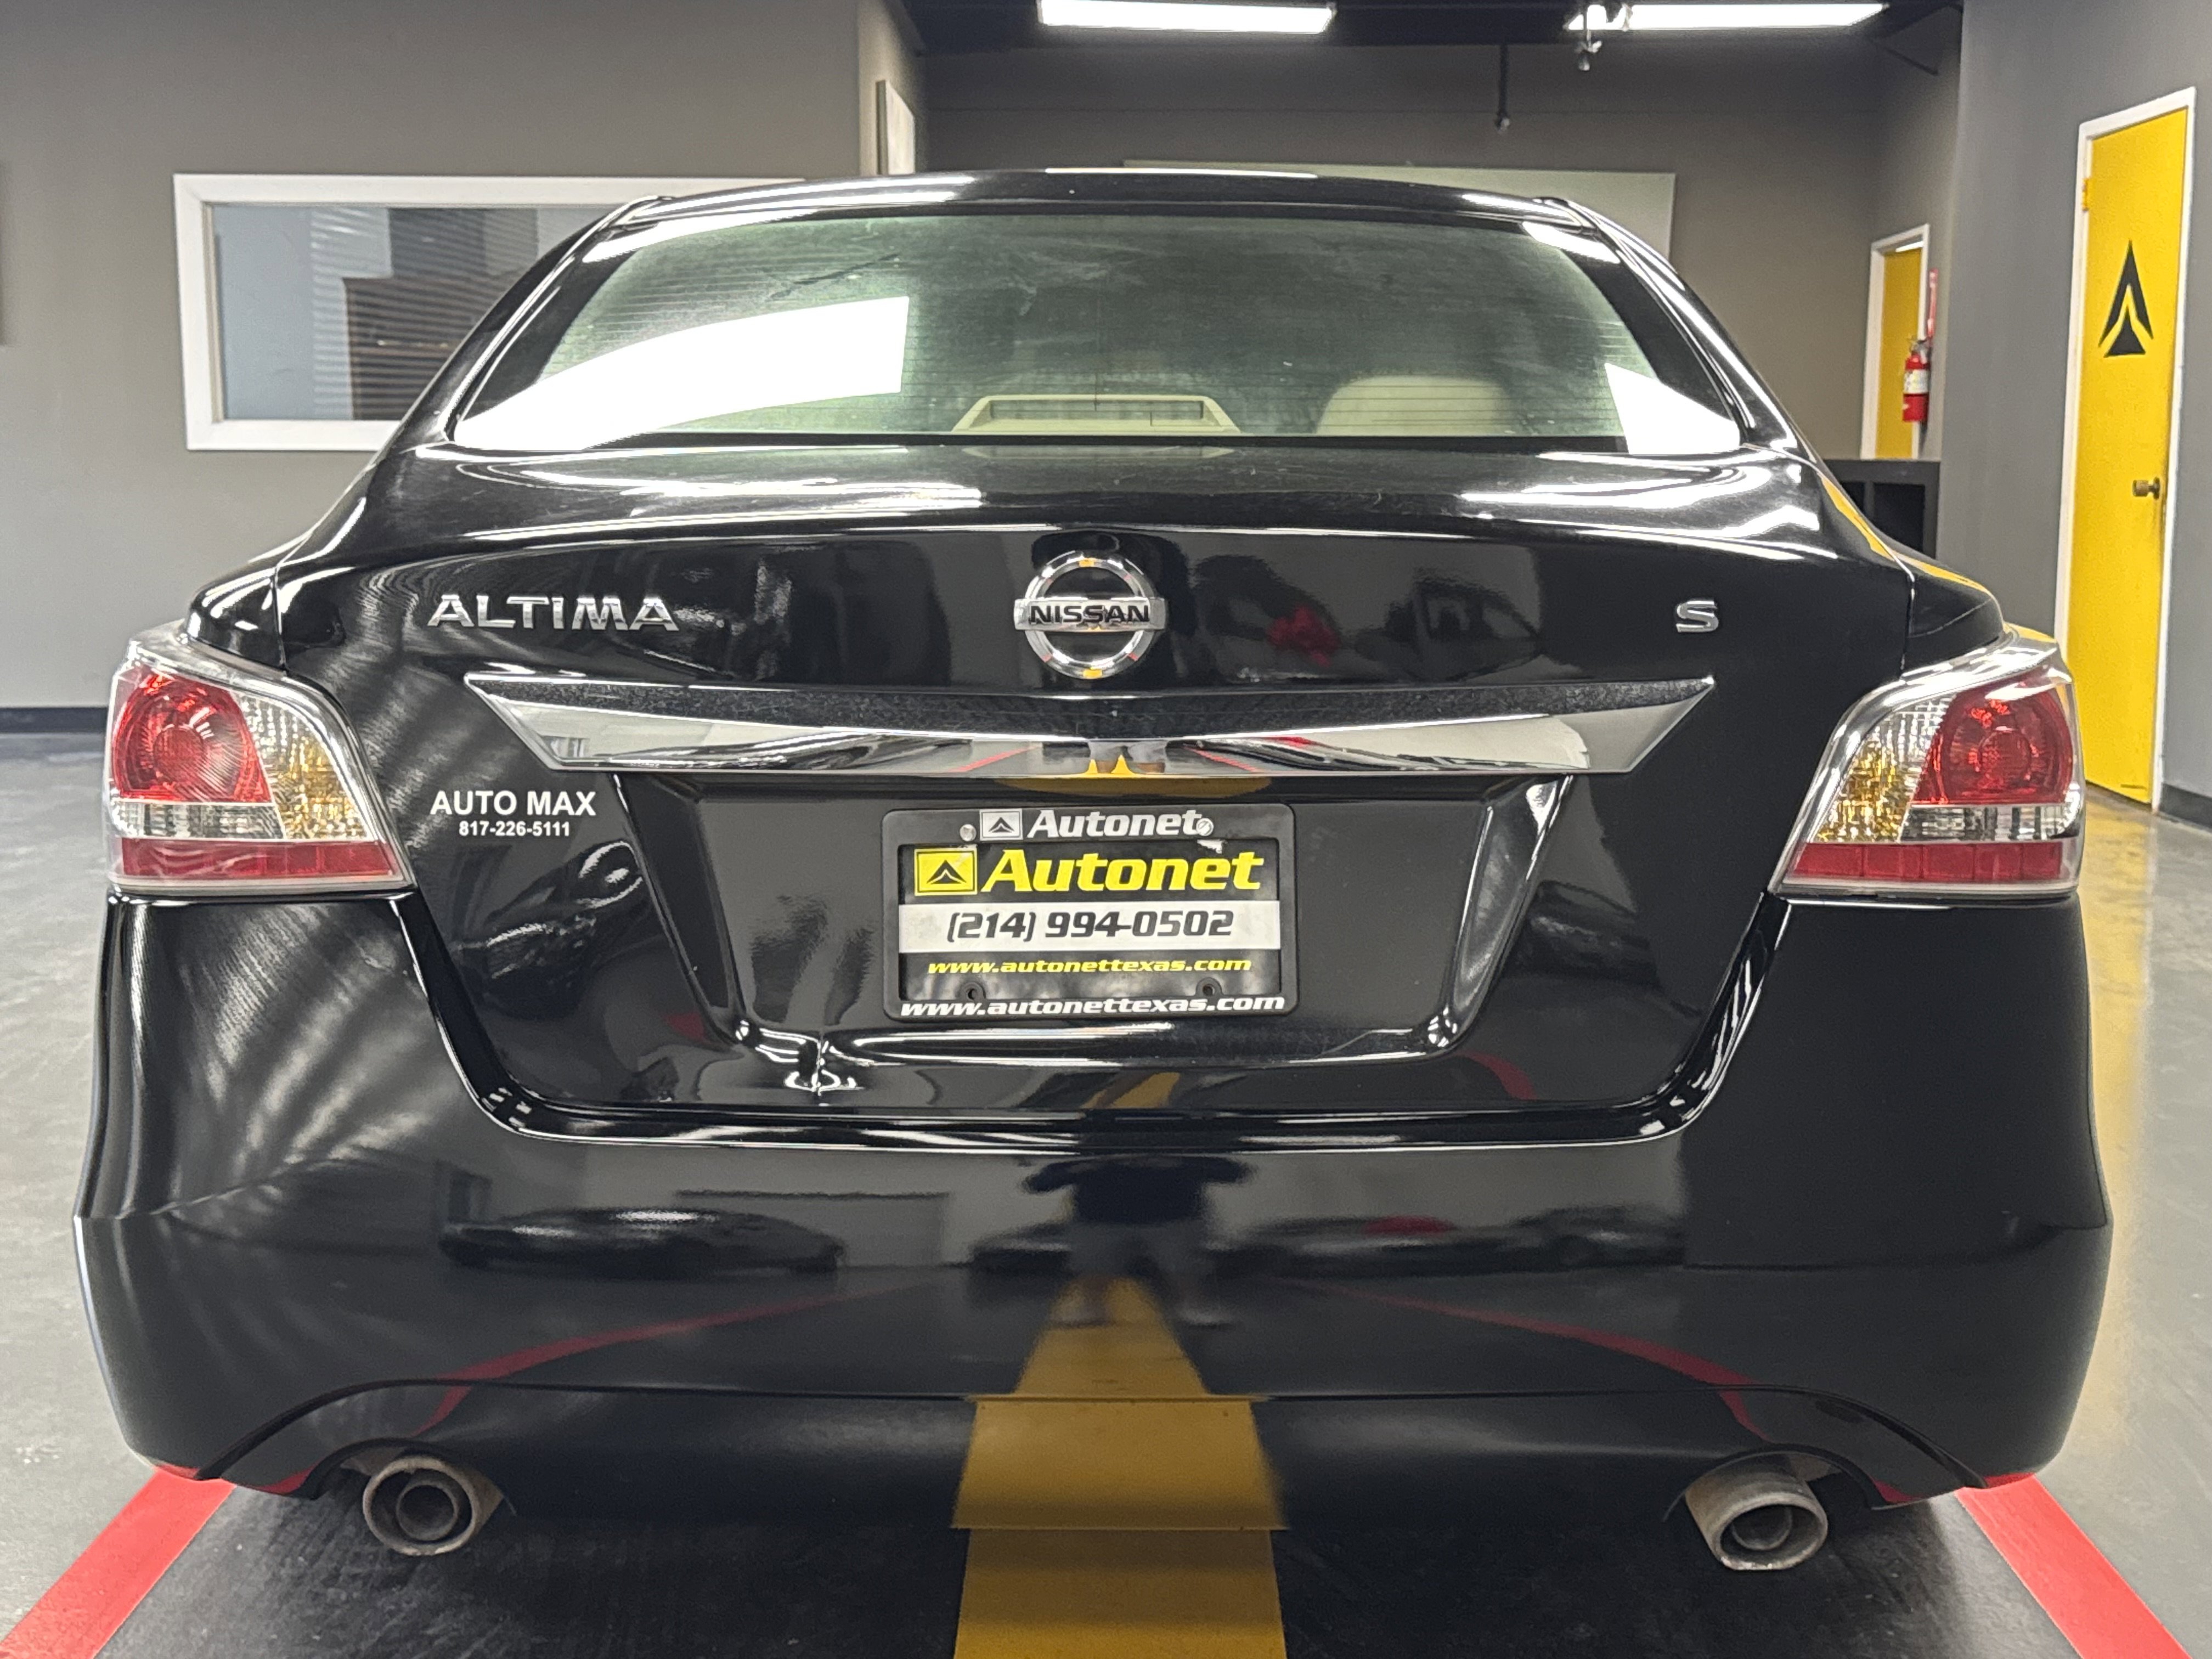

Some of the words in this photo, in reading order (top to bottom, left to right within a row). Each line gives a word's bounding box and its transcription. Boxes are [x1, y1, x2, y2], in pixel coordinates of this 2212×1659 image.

[427, 594, 680, 631] ALTIMA
[1029, 605, 1150, 624] NISSAN
[1675, 600, 1719, 632] S
[430, 790, 517, 816] AUTO
[526, 790, 597, 816] MAX
[459, 821, 570, 837] 817-226-5111
[1028, 809, 1202, 838] Autonet
[981, 848, 1265, 893] Autonet
[947, 911, 1037, 943] (214)
[1045, 910, 1234, 938] 994-0502
[928, 957, 1251, 974] www.autonettexas.com
[900, 995, 1285, 1017] www.autonettexas.com
